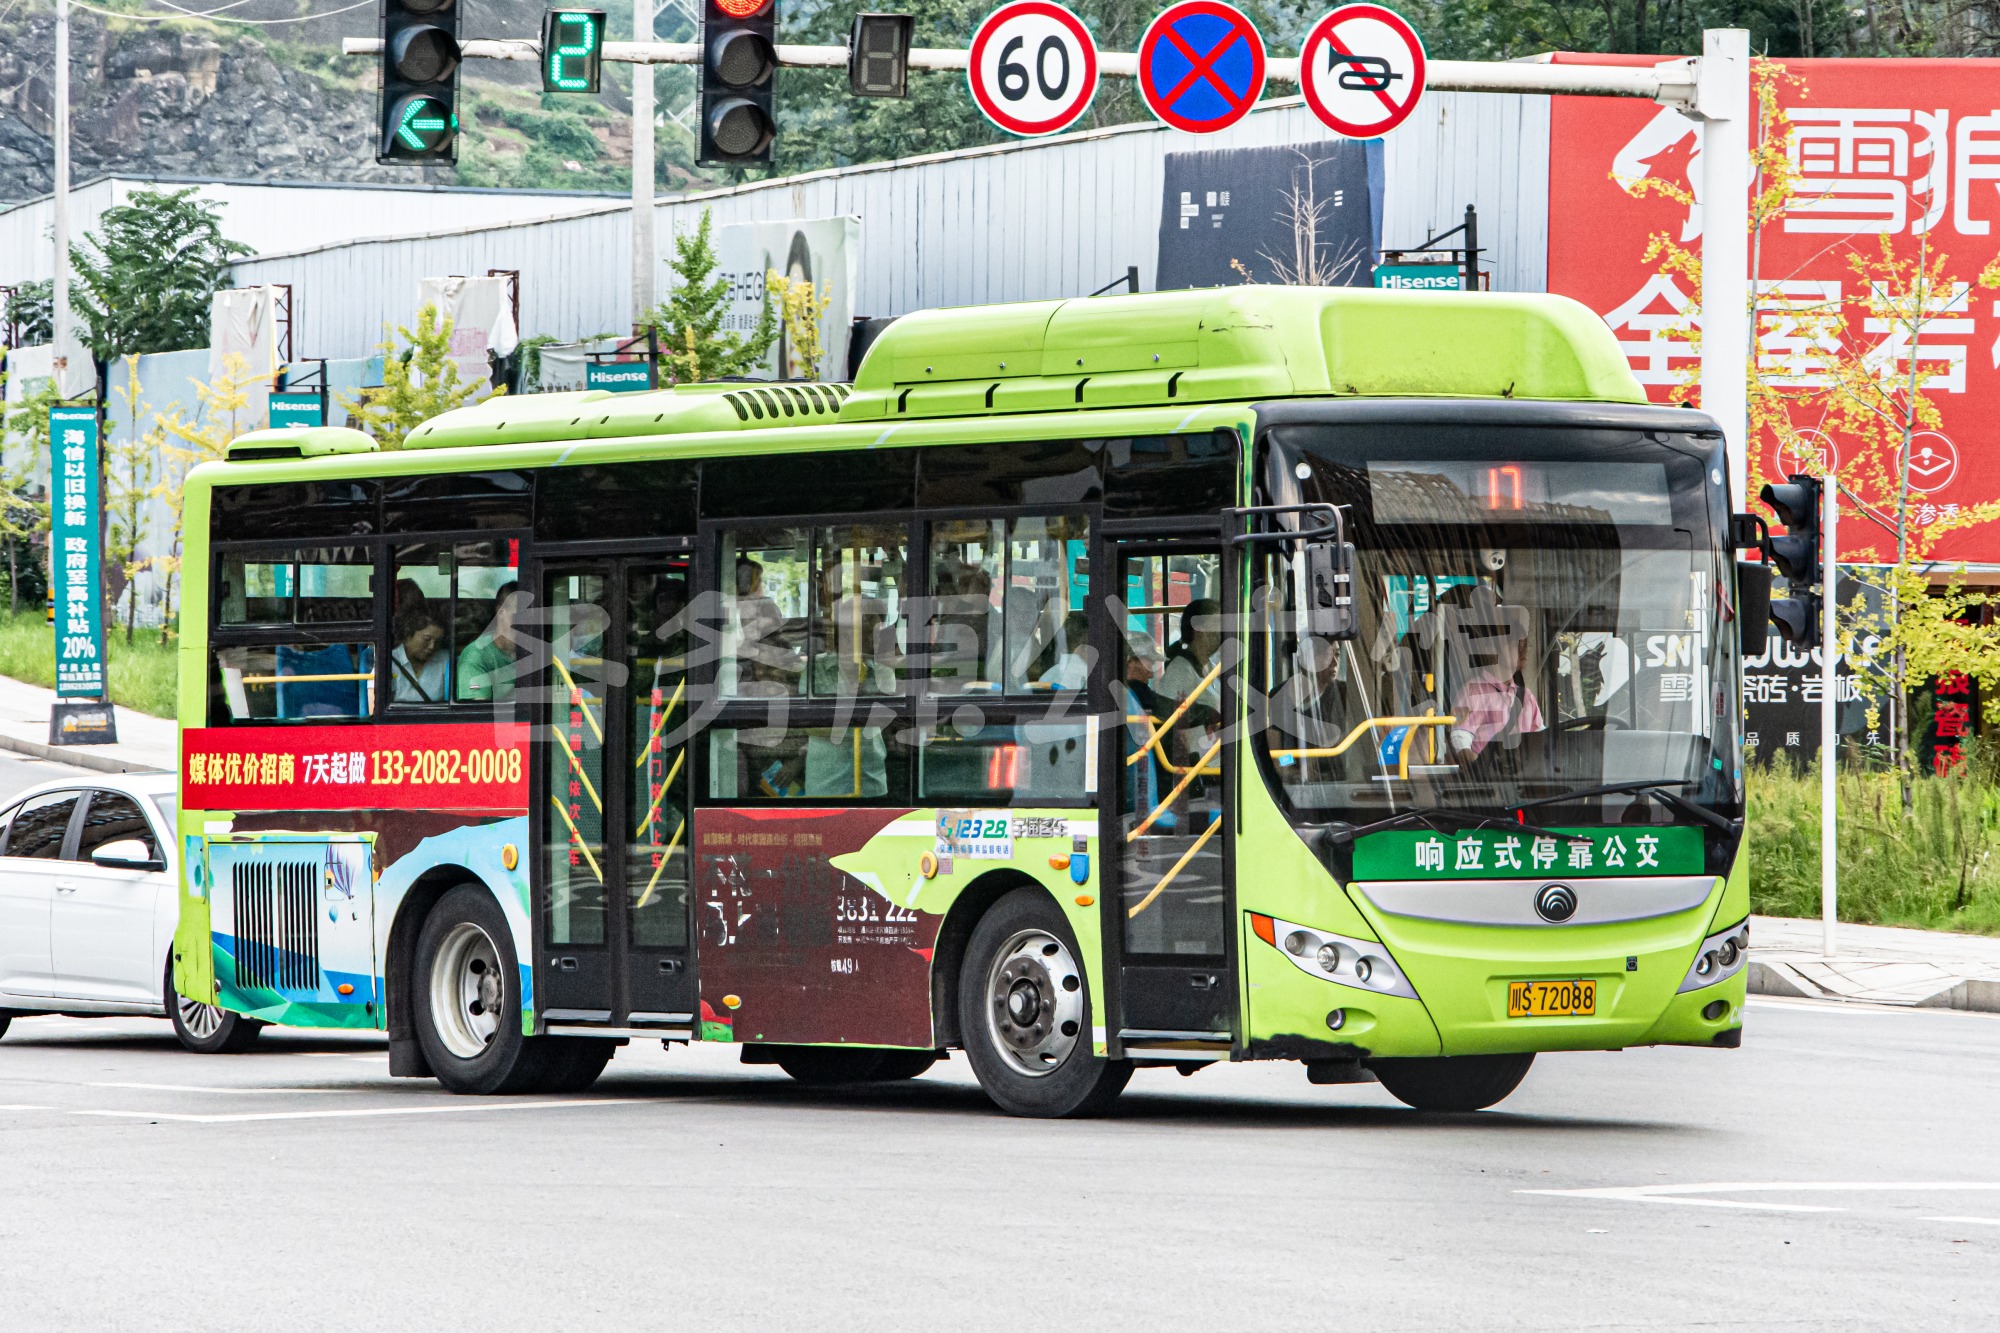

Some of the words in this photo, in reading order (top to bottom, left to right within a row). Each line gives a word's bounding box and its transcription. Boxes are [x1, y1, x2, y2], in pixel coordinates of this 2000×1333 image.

[553, 13, 593, 88] 2
[998, 35, 1070, 101] 60
[1381, 275, 1458, 289] Hisense
[1602, 273, 2000, 393] 全屋岩
[590, 372, 648, 383] Hisense
[271, 401, 320, 411] Hisense
[1489, 466, 1520, 510] 17
[62, 636, 96, 658] 20%
[189, 752, 295, 785] 媒体优价招商
[302, 752, 366, 784] 7天起做
[371, 748, 522, 785] 133-2082-0008
[1415, 834, 1660, 871] 响应式停靠公交
